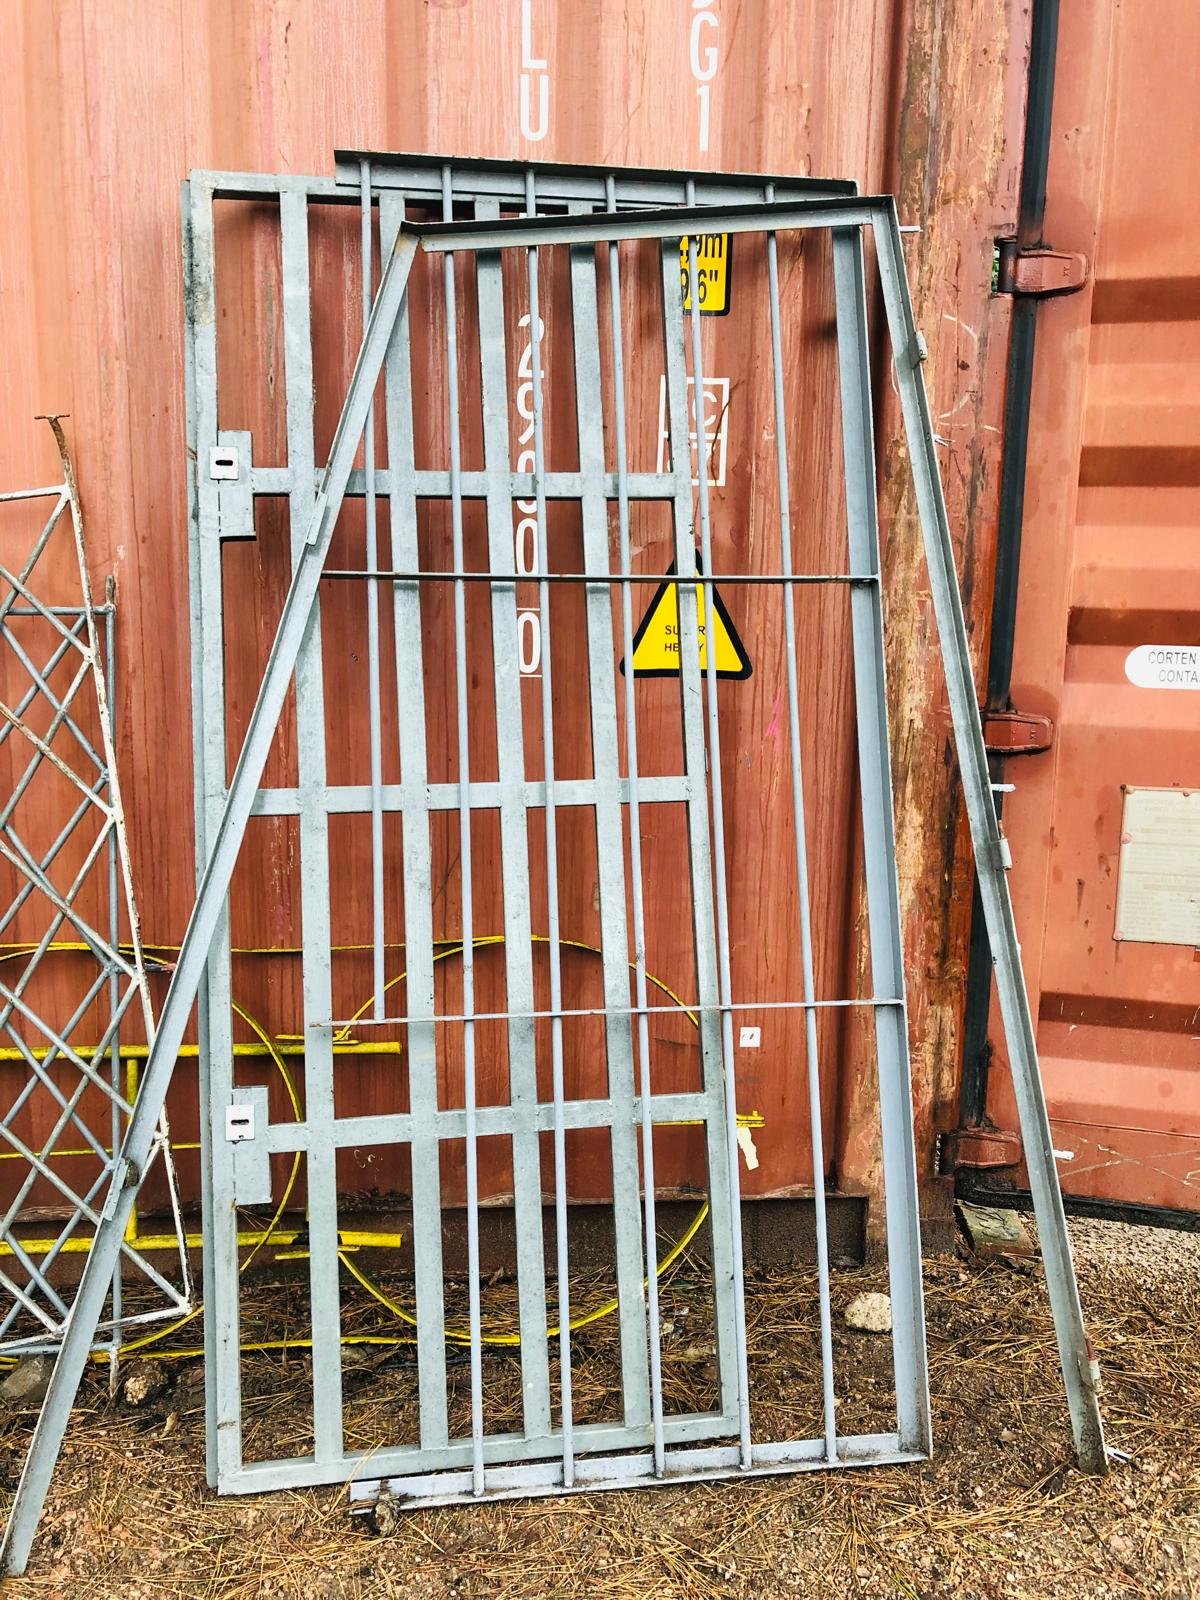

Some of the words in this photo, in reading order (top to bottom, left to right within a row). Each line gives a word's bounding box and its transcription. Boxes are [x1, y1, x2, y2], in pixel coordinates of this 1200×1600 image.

[690, 0, 719, 151] G1
[665, 625, 706, 635] SUR
[1148, 651, 1197, 665] CORTEN
